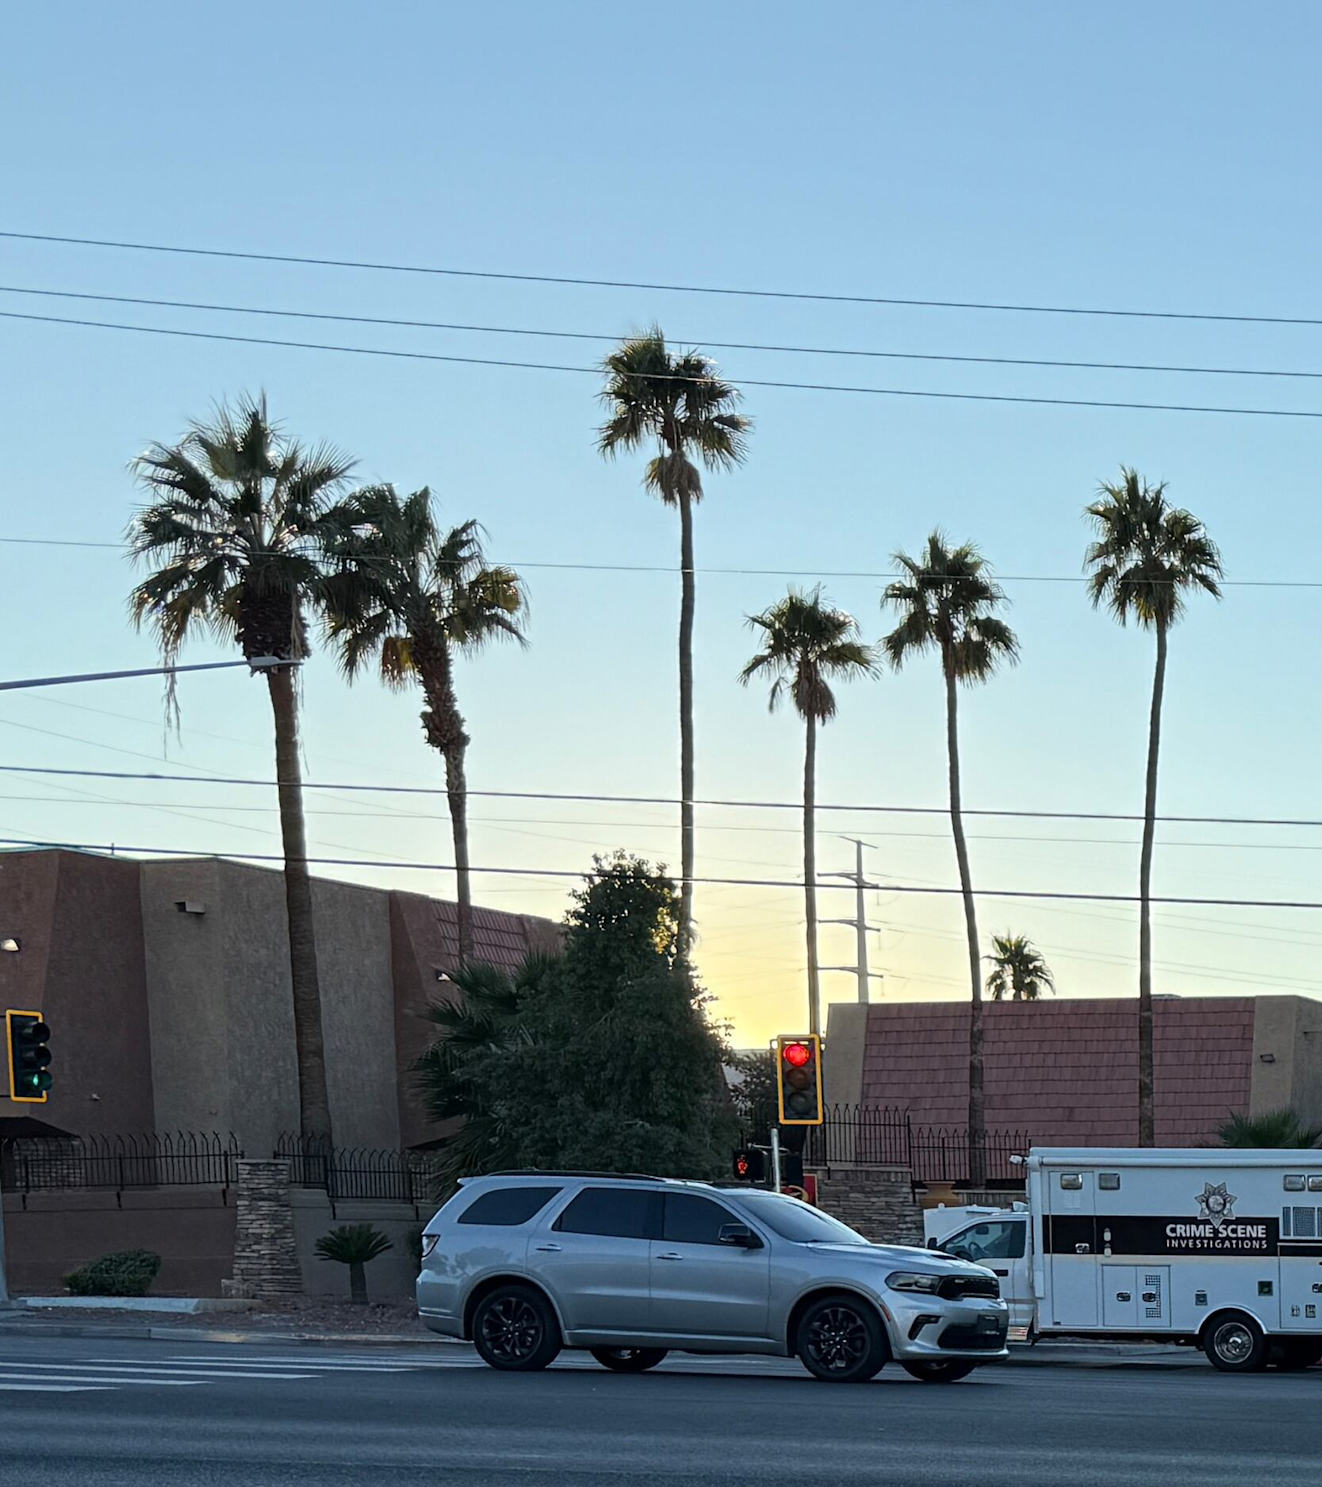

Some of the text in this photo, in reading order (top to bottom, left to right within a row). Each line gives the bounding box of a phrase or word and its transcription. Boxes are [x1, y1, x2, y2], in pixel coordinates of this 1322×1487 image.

[1165, 1223, 1267, 1238] CRIME SCENE
[1166, 1238, 1268, 1249] INVESTIGATIONS
